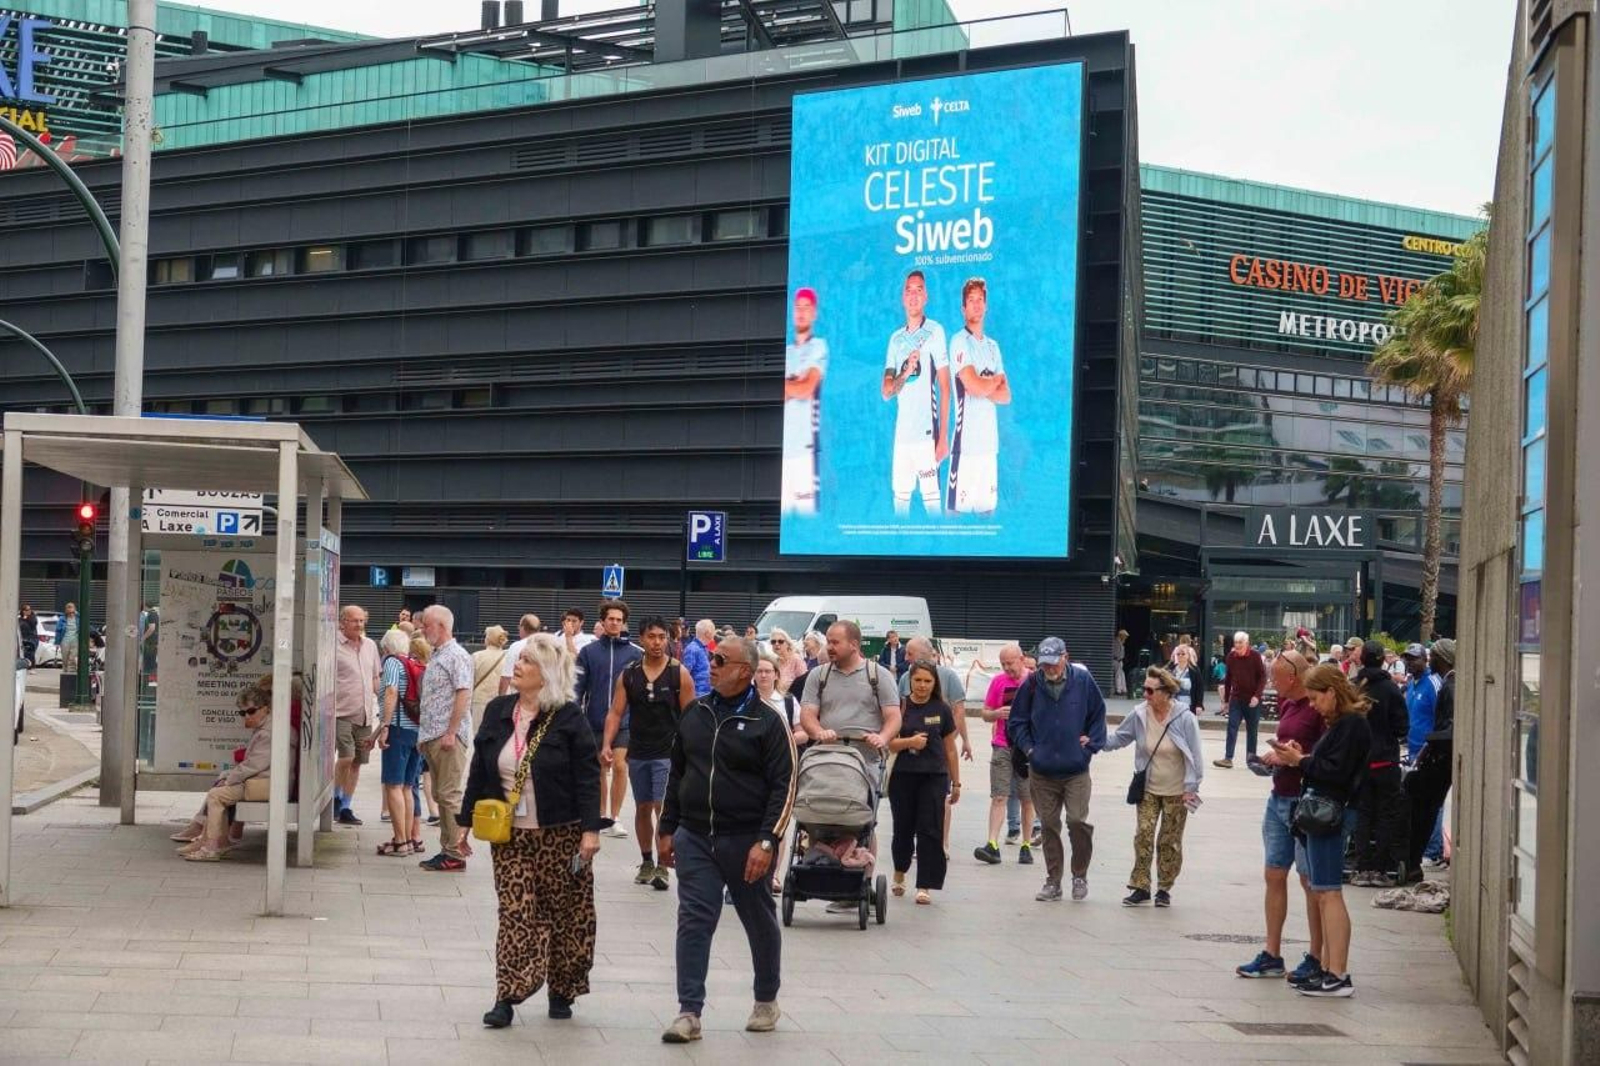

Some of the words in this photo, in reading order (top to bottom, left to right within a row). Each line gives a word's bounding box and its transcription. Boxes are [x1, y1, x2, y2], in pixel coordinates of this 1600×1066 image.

[893, 104, 921, 118] Siweb
[944, 101, 970, 112] CELTA
[865, 143, 891, 166] KIT
[896, 137, 960, 164] DIGITAL
[864, 161, 995, 211] CELESTE
[895, 208, 993, 254] Siweb
[1404, 235, 1451, 255] CENTRO
[1230, 254, 1330, 296] CASINO
[1339, 273, 1369, 300] DE
[1379, 274, 1424, 306] VIG
[1279, 310, 1393, 346] METROPO
[142, 520, 150, 530] A
[160, 521, 193, 532] Laxe
[220, 514, 235, 532] P
[157, 508, 209, 519] Comercial
[691, 514, 712, 543] P
[1257, 514, 1277, 545] A
[1289, 514, 1364, 546] LAXE
[197, 680, 237, 688] MEETING
